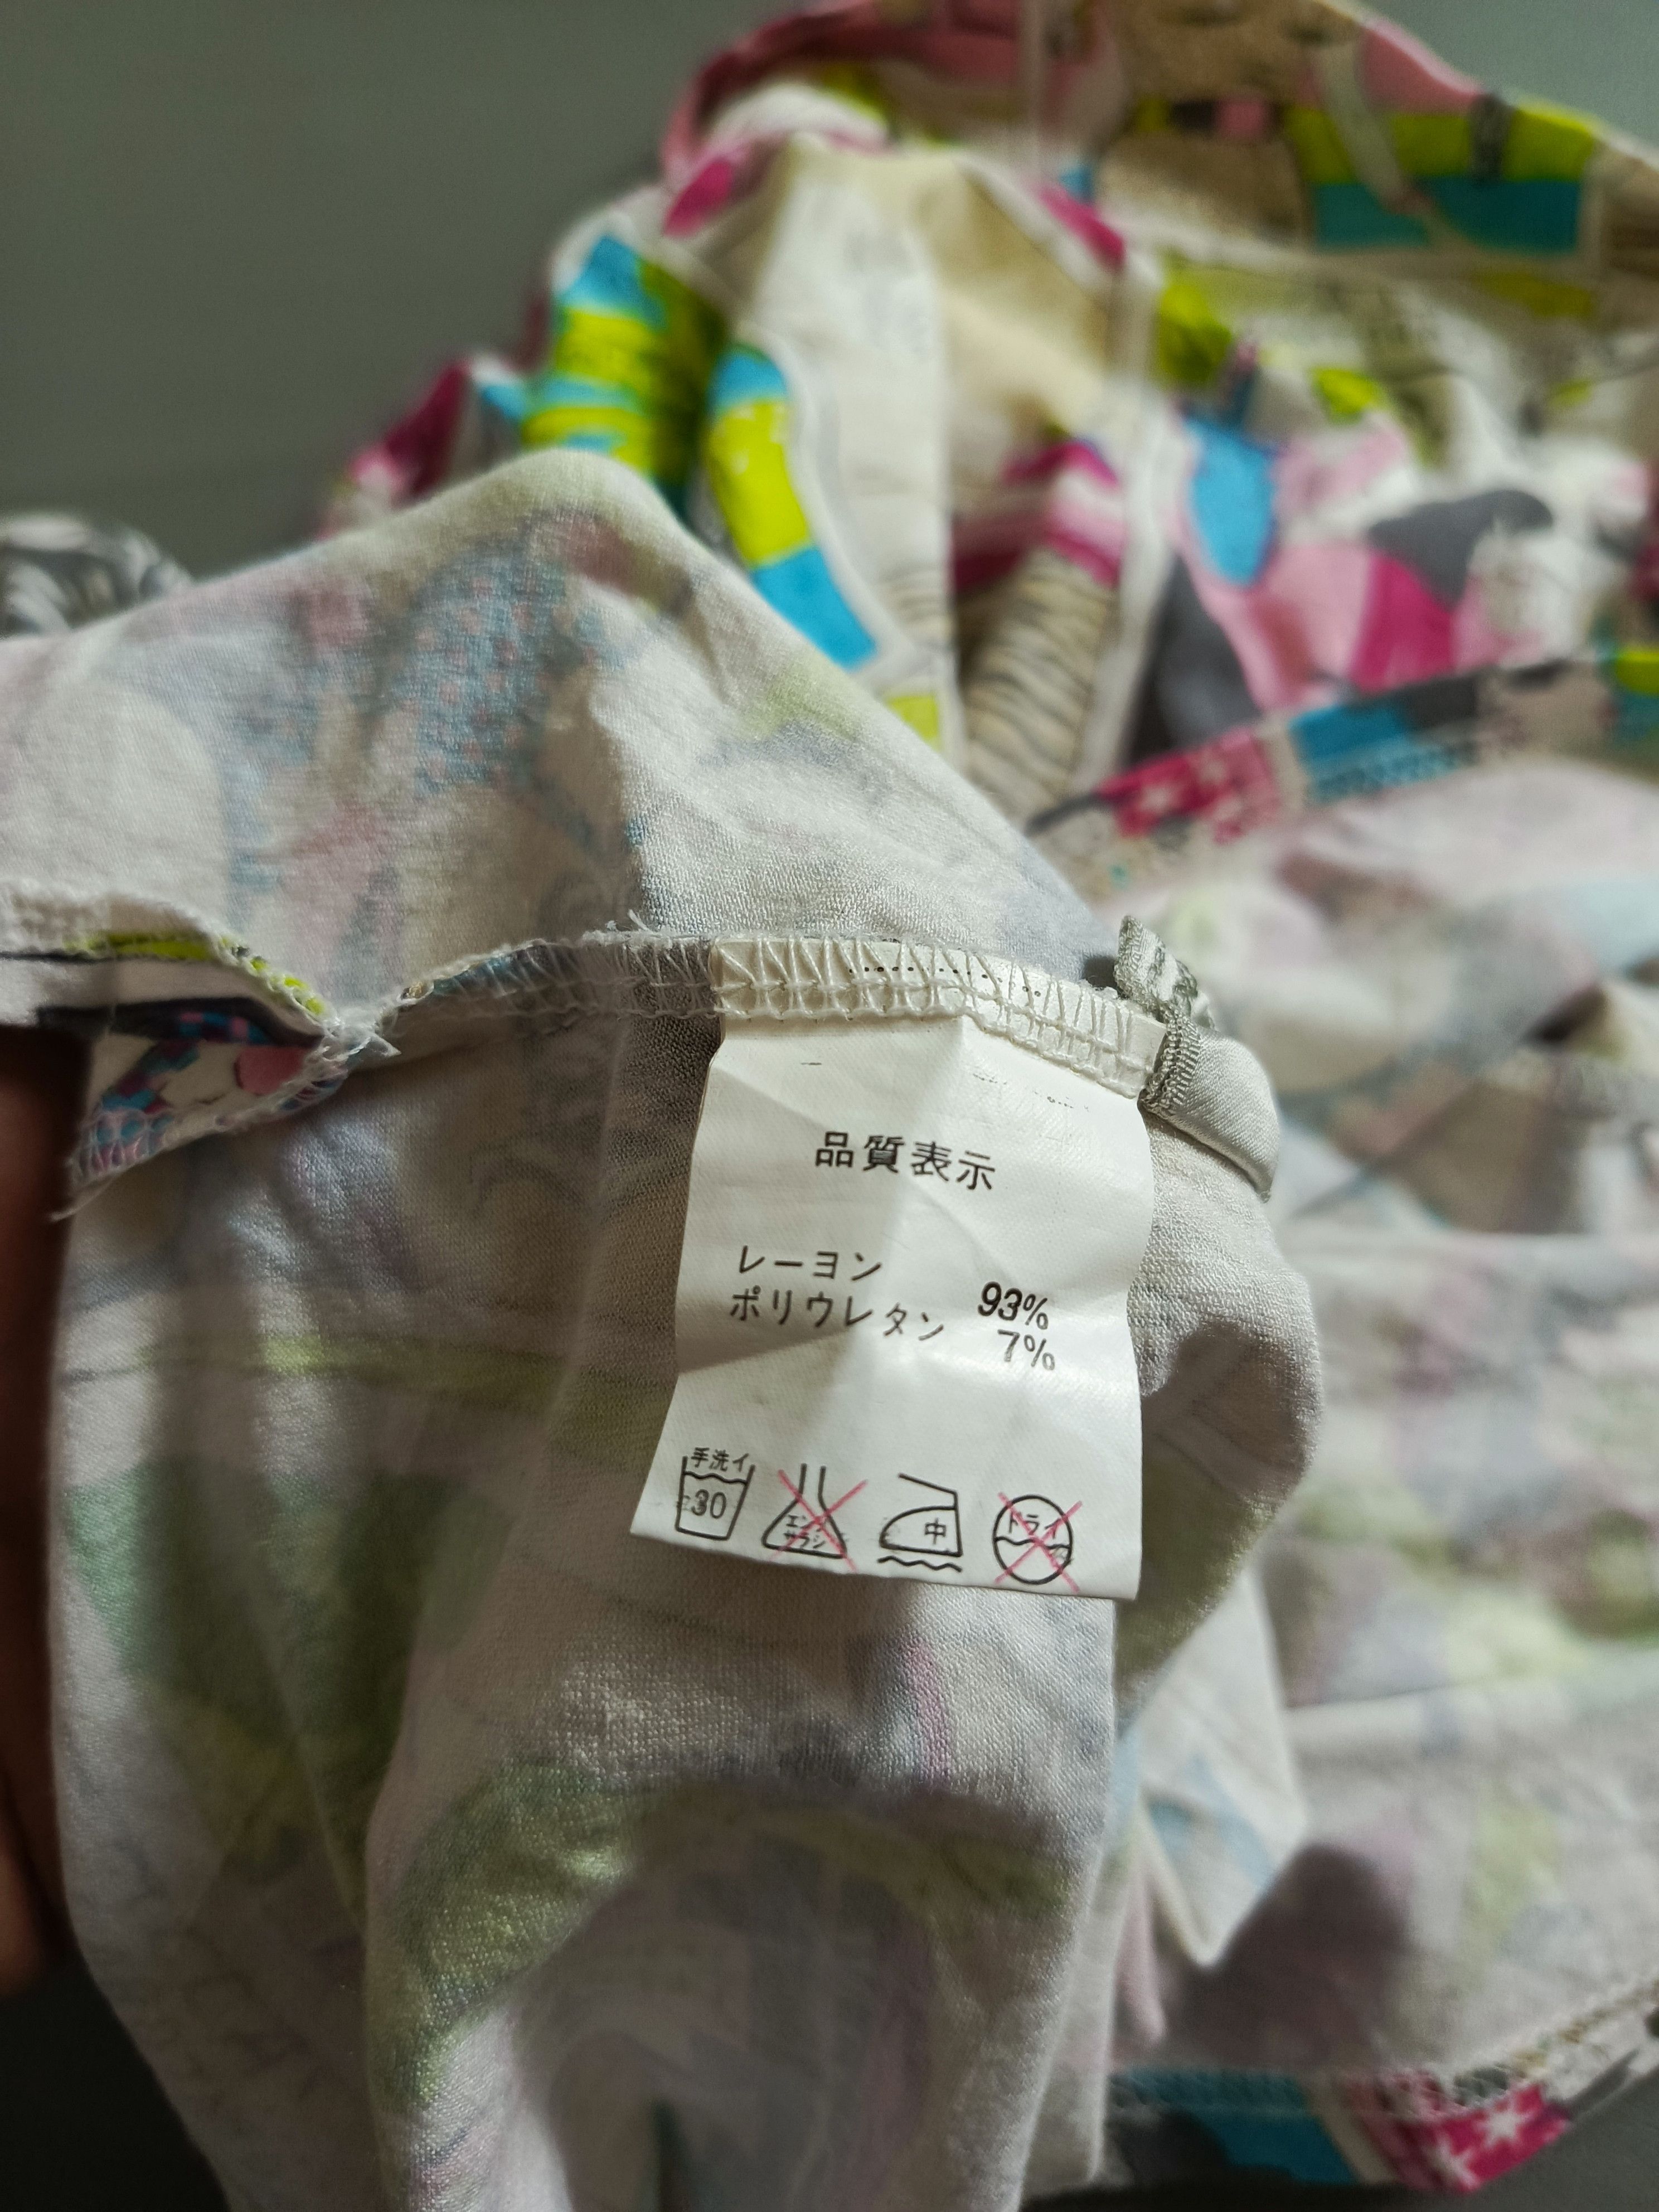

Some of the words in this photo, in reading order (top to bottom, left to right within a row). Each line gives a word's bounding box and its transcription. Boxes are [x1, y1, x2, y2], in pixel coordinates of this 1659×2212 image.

[816, 1131, 996, 1190] 品質表示
[739, 1245, 882, 1282] レーヨン
[977, 1281, 1048, 1330] 93%
[730, 1285, 944, 1341] ポリウレタン
[997, 1328, 1055, 1371] 7%
[691, 1447, 749, 1472] 手洗イ
[691, 1488, 726, 1519] 30
[924, 1517, 947, 1545] 中
